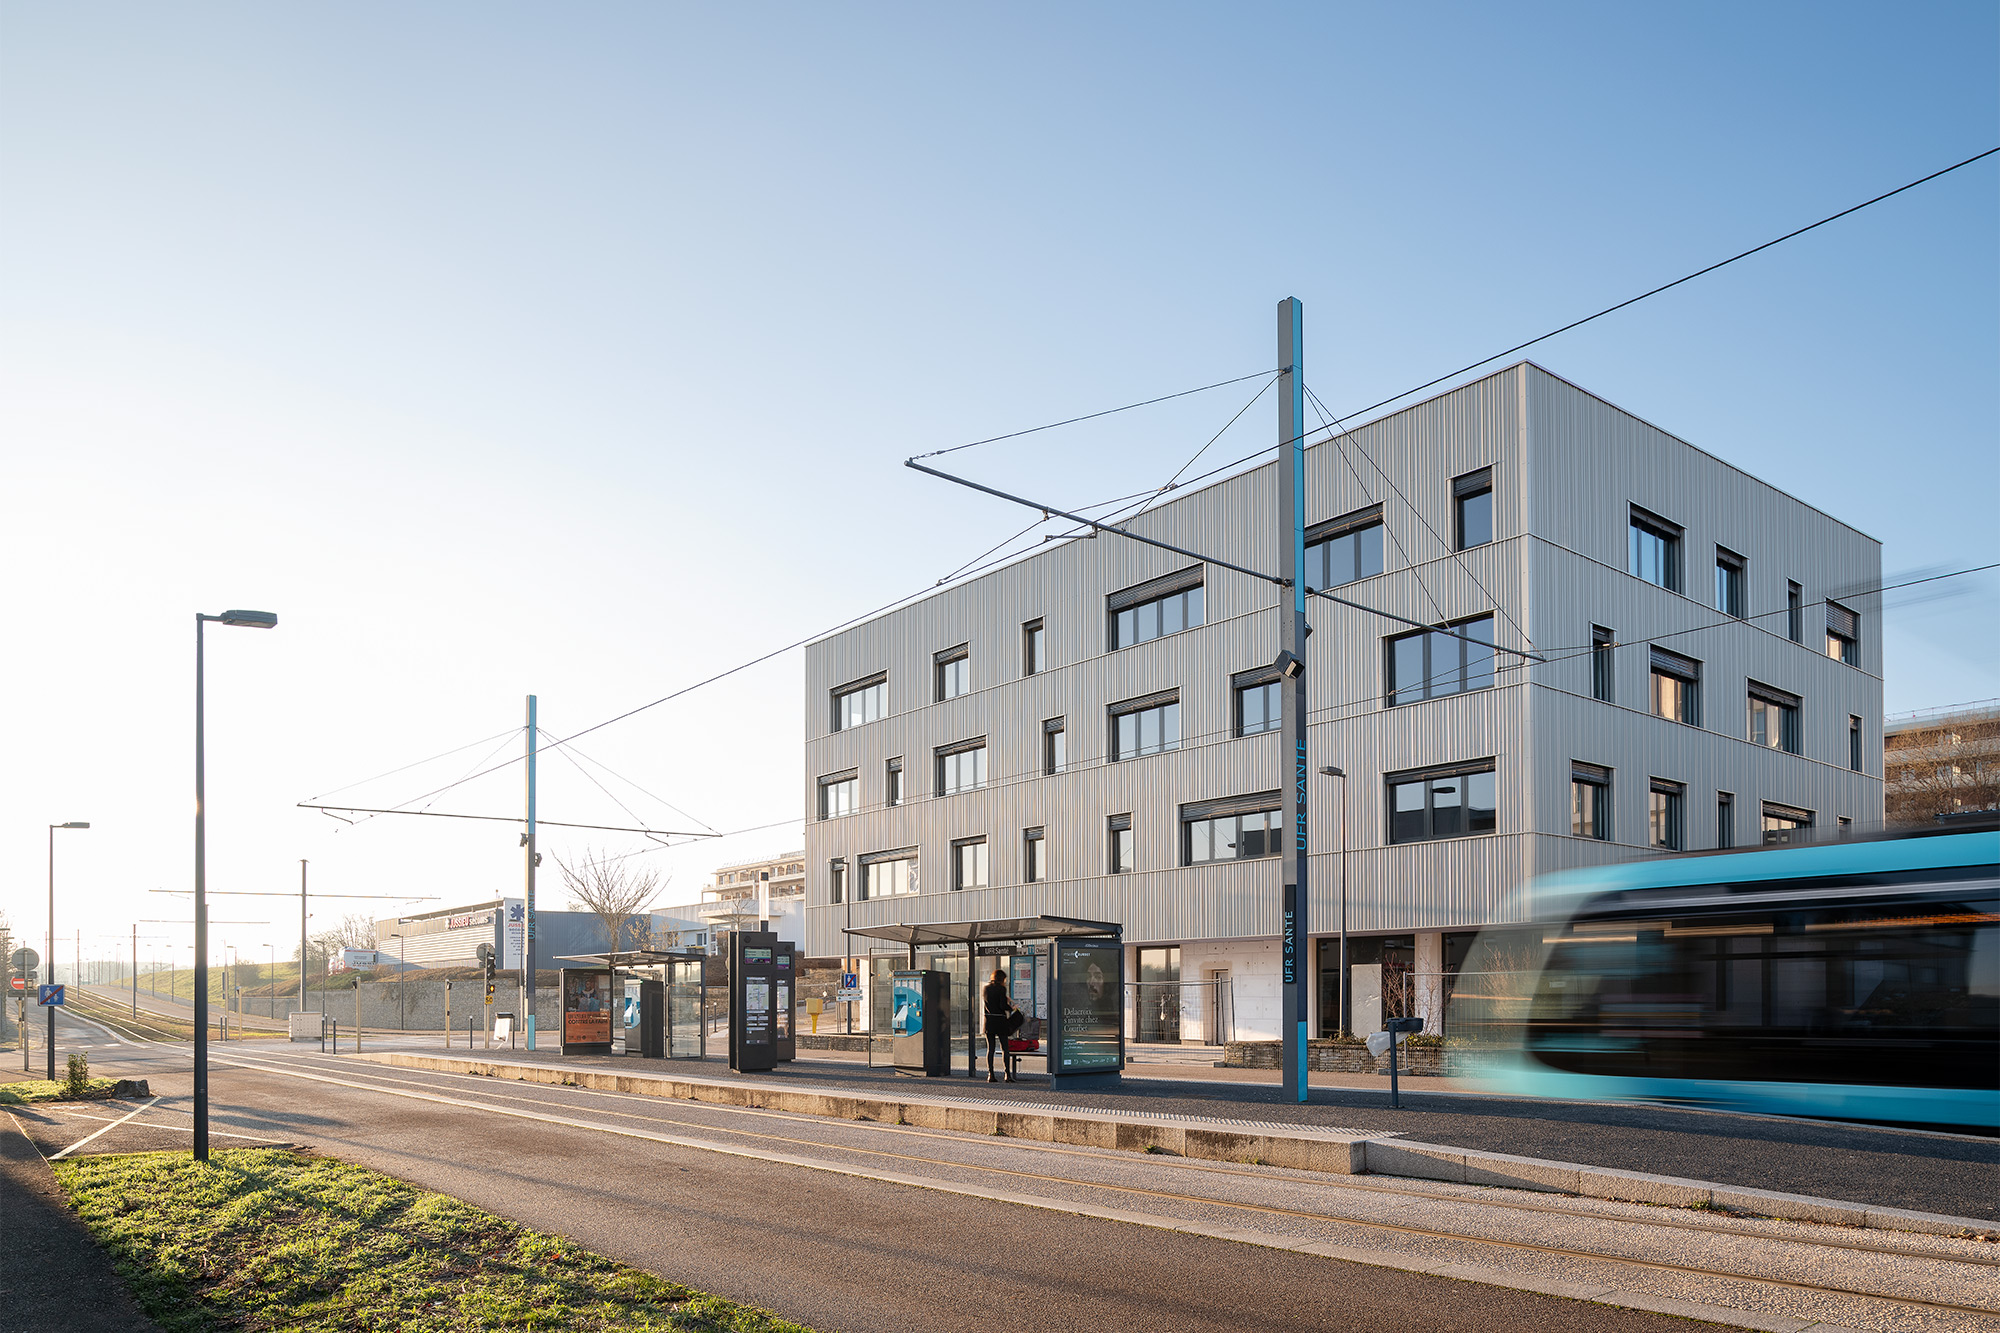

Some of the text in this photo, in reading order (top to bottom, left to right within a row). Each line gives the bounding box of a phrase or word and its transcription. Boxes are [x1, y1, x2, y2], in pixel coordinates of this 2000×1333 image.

[1296, 739, 1306, 850] UFR SANTE
[528, 889, 536, 940] UFR SANTE
[995, 947, 1009, 955] Santé
[1285, 911, 1294, 982] UFR SANTE
[1063, 1007, 1093, 1016] Delacroix
[1085, 1015, 1099, 1023] chez
[1063, 1024, 1088, 1032] Courbet
